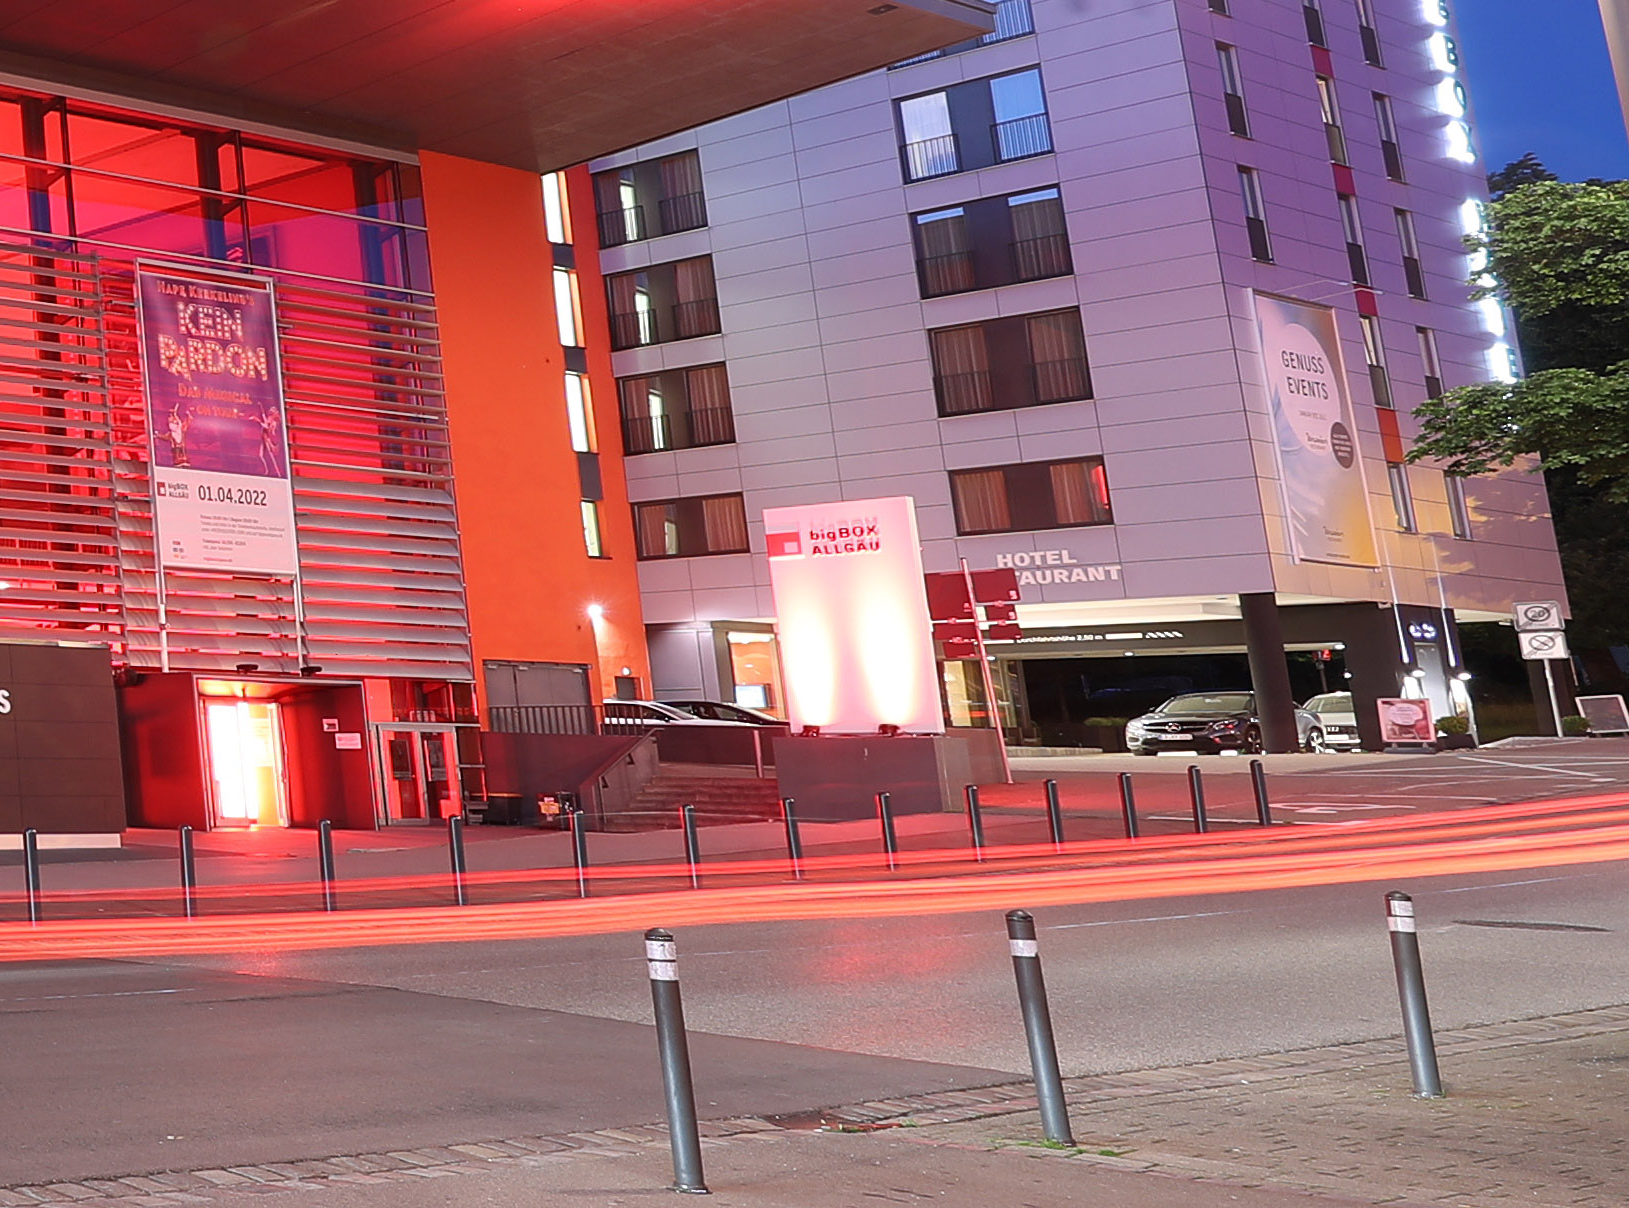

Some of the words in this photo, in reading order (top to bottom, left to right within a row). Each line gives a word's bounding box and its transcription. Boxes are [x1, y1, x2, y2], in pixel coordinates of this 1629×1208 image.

[177, 302, 244, 342] KEIN
[158, 334, 268, 382] PARDON
[1281, 350, 1325, 375] GENUSS
[1287, 376, 1329, 400] EVENTS
[198, 484, 267, 506] 01.04.2022
[809, 525, 878, 542] bigBOX
[812, 539, 881, 556] ALLGÄU
[996, 550, 1078, 568] HOTEL
